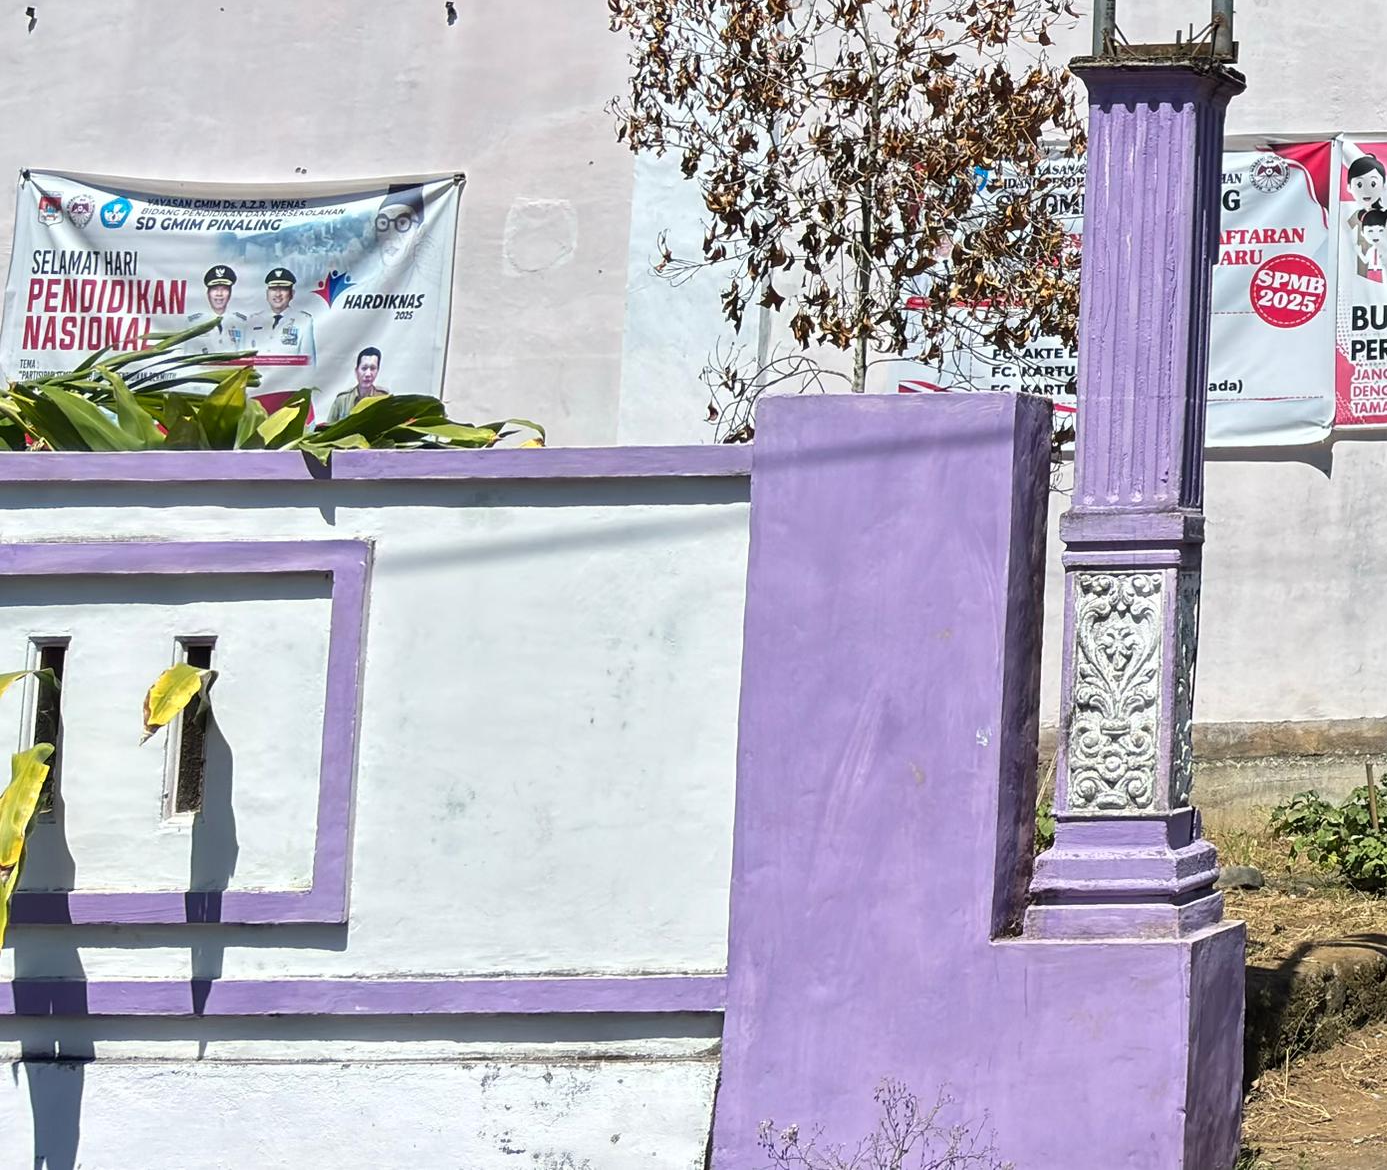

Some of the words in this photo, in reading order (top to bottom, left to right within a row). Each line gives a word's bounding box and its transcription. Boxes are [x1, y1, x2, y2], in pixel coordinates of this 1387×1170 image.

[148, 198, 192, 209] YAYASAN
[194, 199, 221, 209] GMIM
[223, 200, 237, 209] Ds.
[271, 200, 307, 209] WENAS
[141, 208, 180, 216] BIDANG
[182, 209, 242, 217] PENDIDIKAN
[269, 208, 346, 217] PERSEKOLAHAN
[135, 217, 156, 230] SD
[160, 218, 205, 230] GMIM
[206, 219, 282, 230] PINALING
[1219, 228, 1305, 245] AFTARAN
[32, 250, 100, 275] SELAMAT
[104, 251, 138, 276] HARI
[1220, 250, 1263, 265] ARU
[1255, 270, 1325, 294] SPMB
[27, 278, 187, 314] PENDIDIKAN
[343, 294, 425, 309] HARDIKNAS
[1258, 290, 1316, 312] 2025
[394, 311, 413, 320] 2025
[22, 316, 155, 351] NASIONAL
[1022, 349, 1063, 359] AKTE
[20, 360, 36, 368] TEMA
[992, 367, 1016, 377] FC.
[1022, 366, 1075, 376] KARTU
